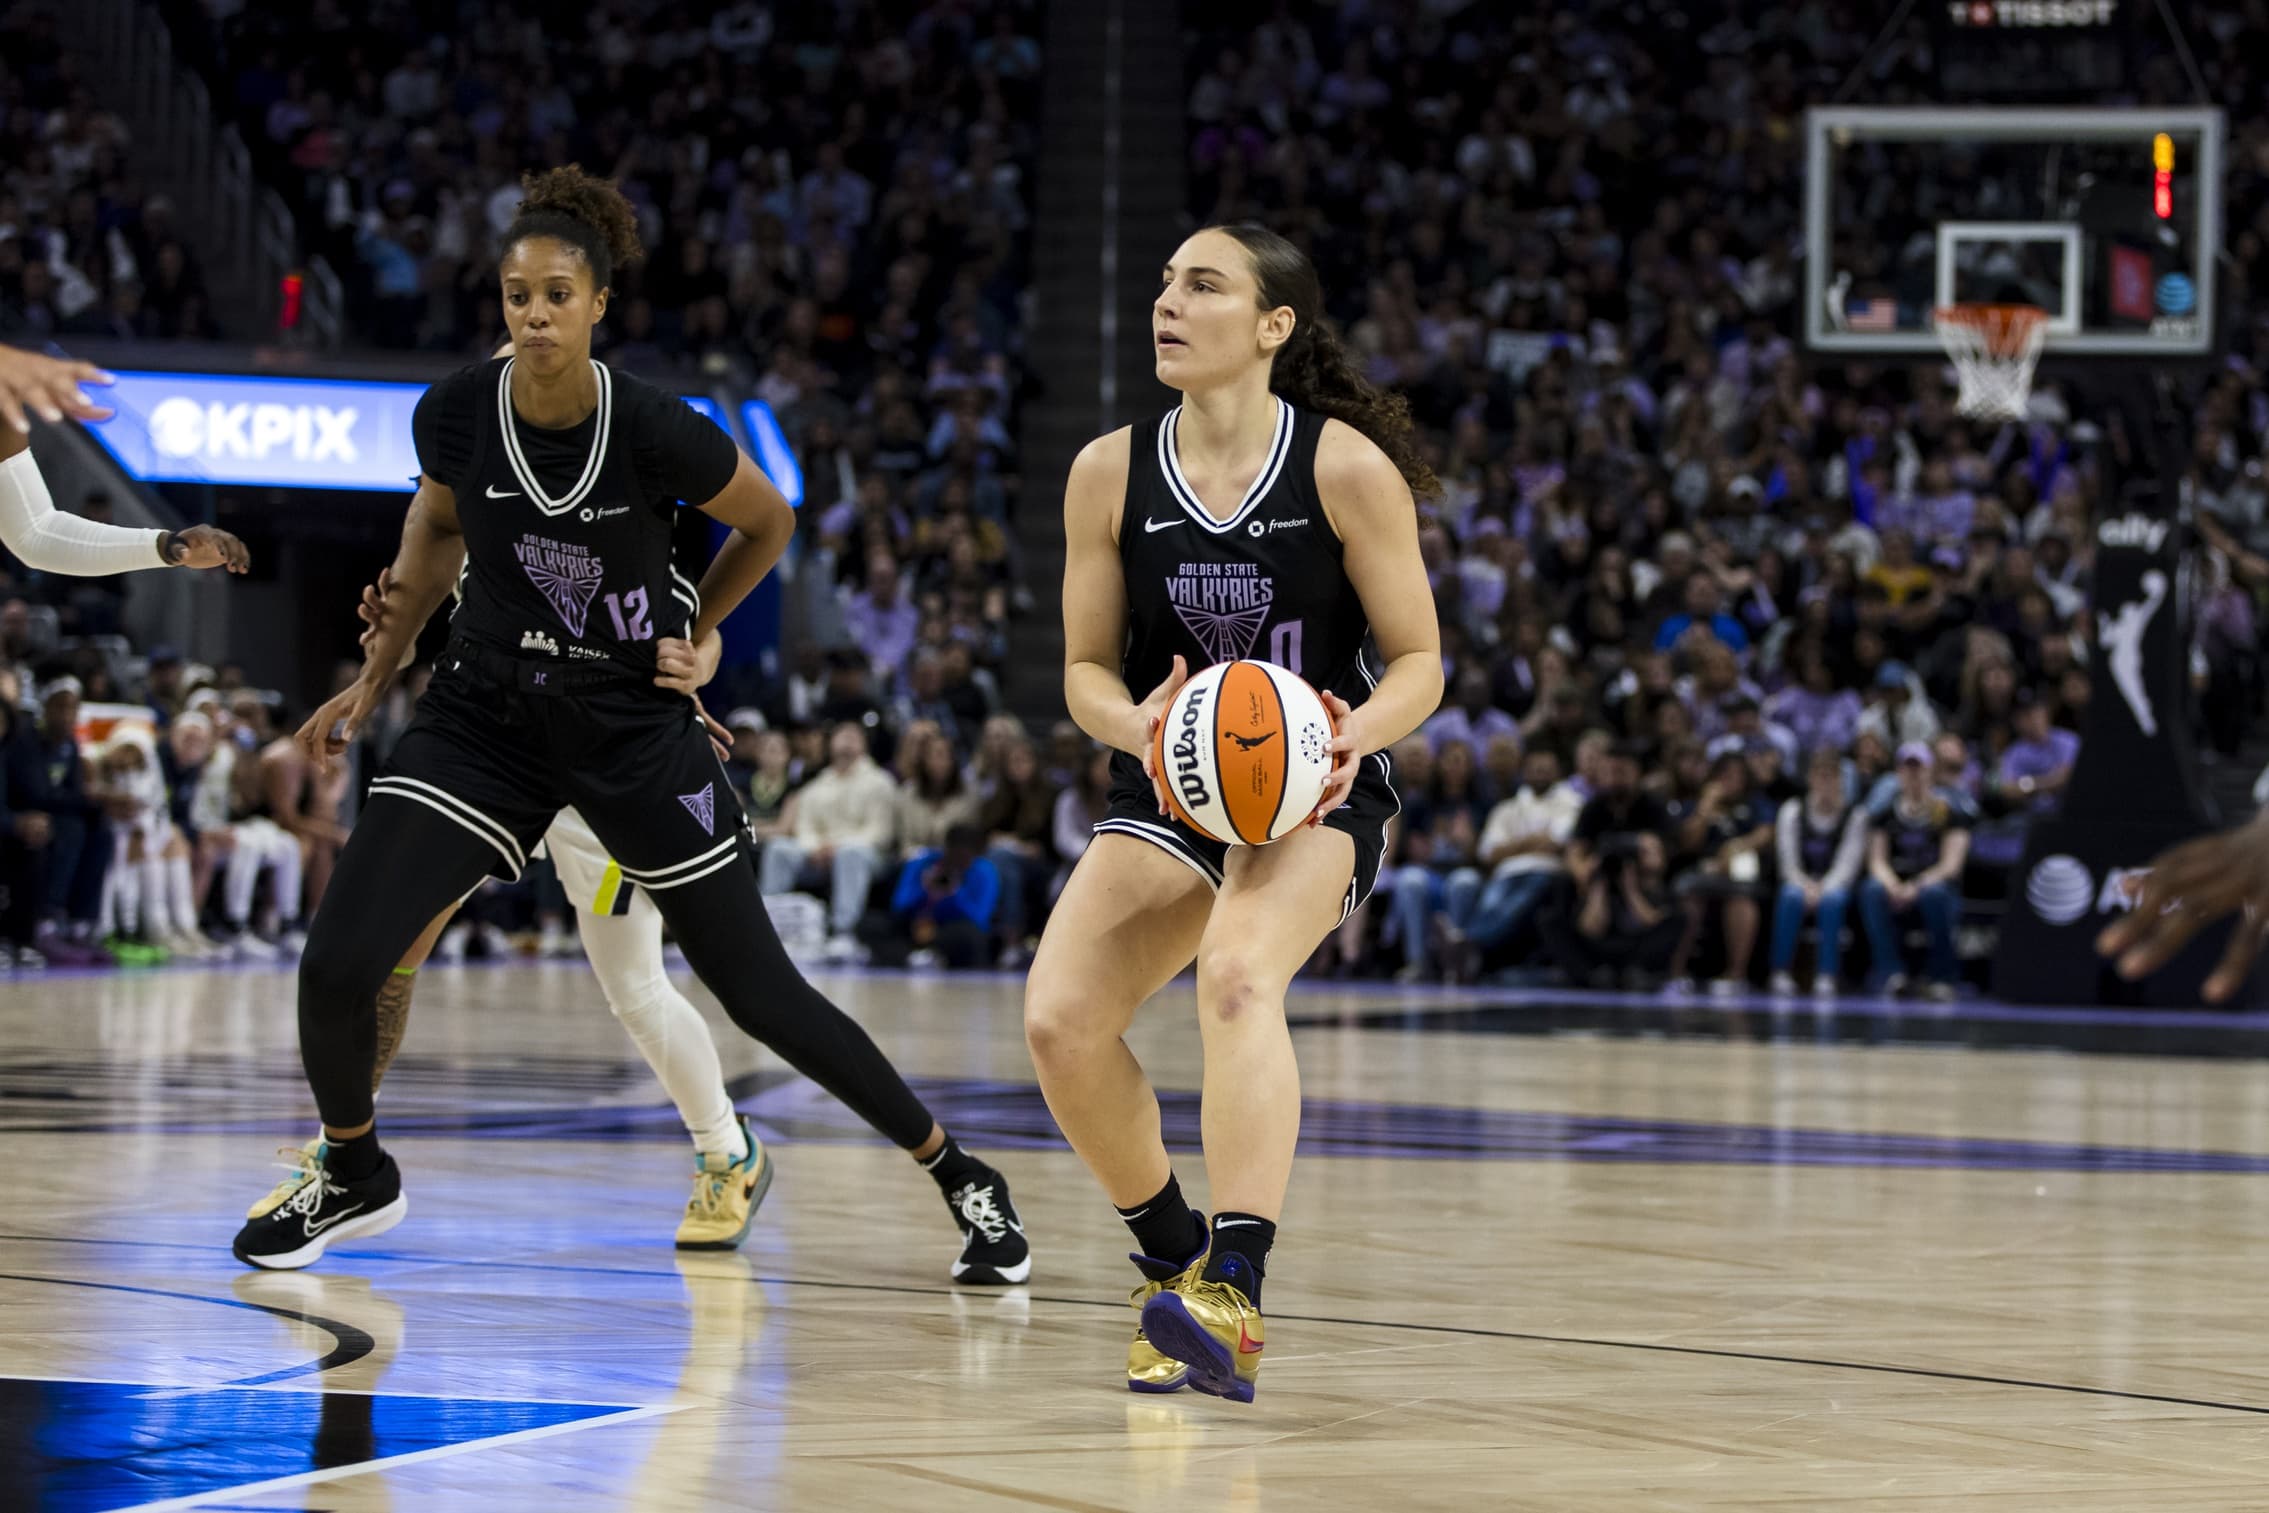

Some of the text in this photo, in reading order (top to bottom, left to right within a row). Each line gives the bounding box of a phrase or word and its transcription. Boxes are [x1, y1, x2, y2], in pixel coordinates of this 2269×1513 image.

[1997, 1, 2116, 27] TISSOT
[206, 400, 359, 464] KPIX
[597, 505, 630, 520] freedom
[1268, 517, 1309, 534] freedom
[522, 533, 590, 556] GOLDEN STATE
[2097, 510, 2168, 555] ally
[513, 542, 604, 579] VALKYRIES
[1178, 562, 1259, 576] GOLDEN STATE
[603, 584, 654, 641] 12
[1165, 576, 1274, 614] VALKYRIES
[1173, 686, 1210, 811] Wilson
